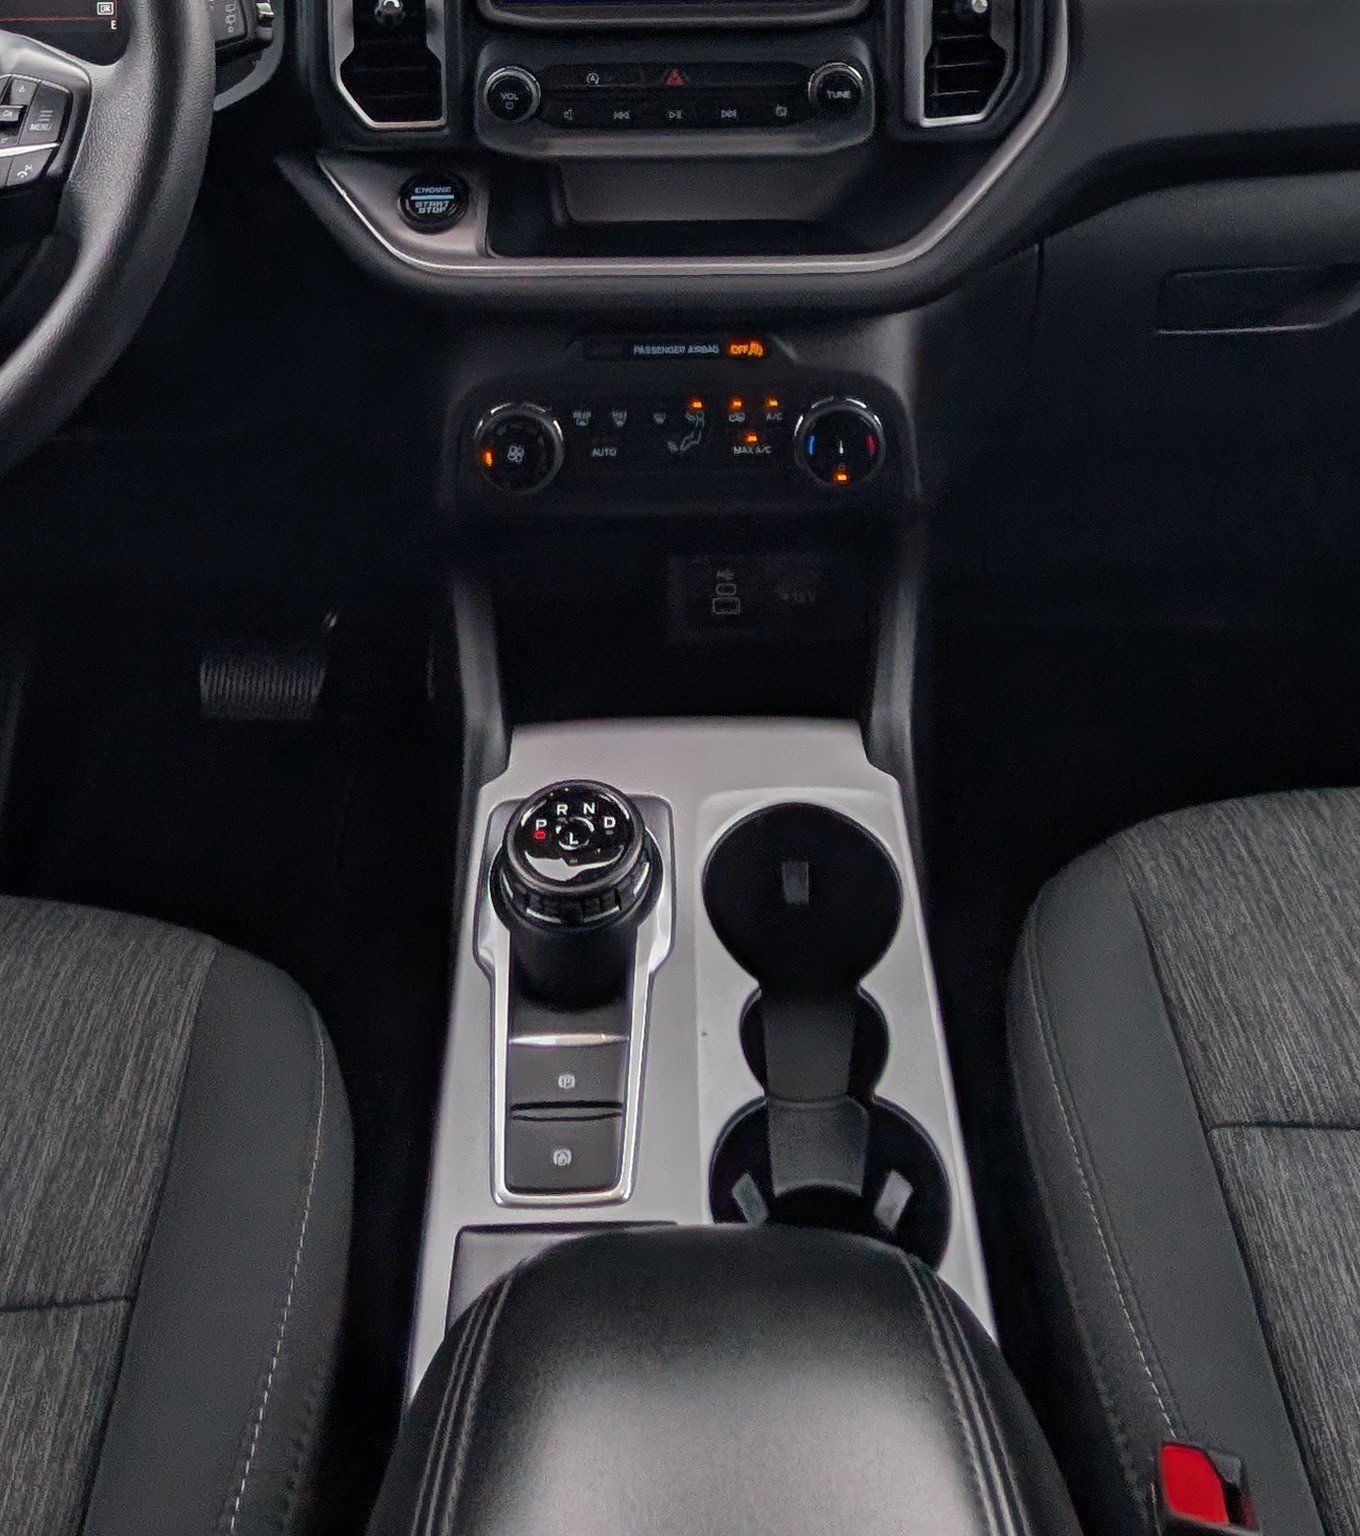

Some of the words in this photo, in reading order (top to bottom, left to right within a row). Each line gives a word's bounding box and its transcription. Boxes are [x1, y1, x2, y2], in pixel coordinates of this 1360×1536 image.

[556, 804, 569, 816] R
[583, 802, 596, 815] N
[535, 818, 548, 830] P
[603, 816, 616, 829] D
[569, 832, 579, 845] L
